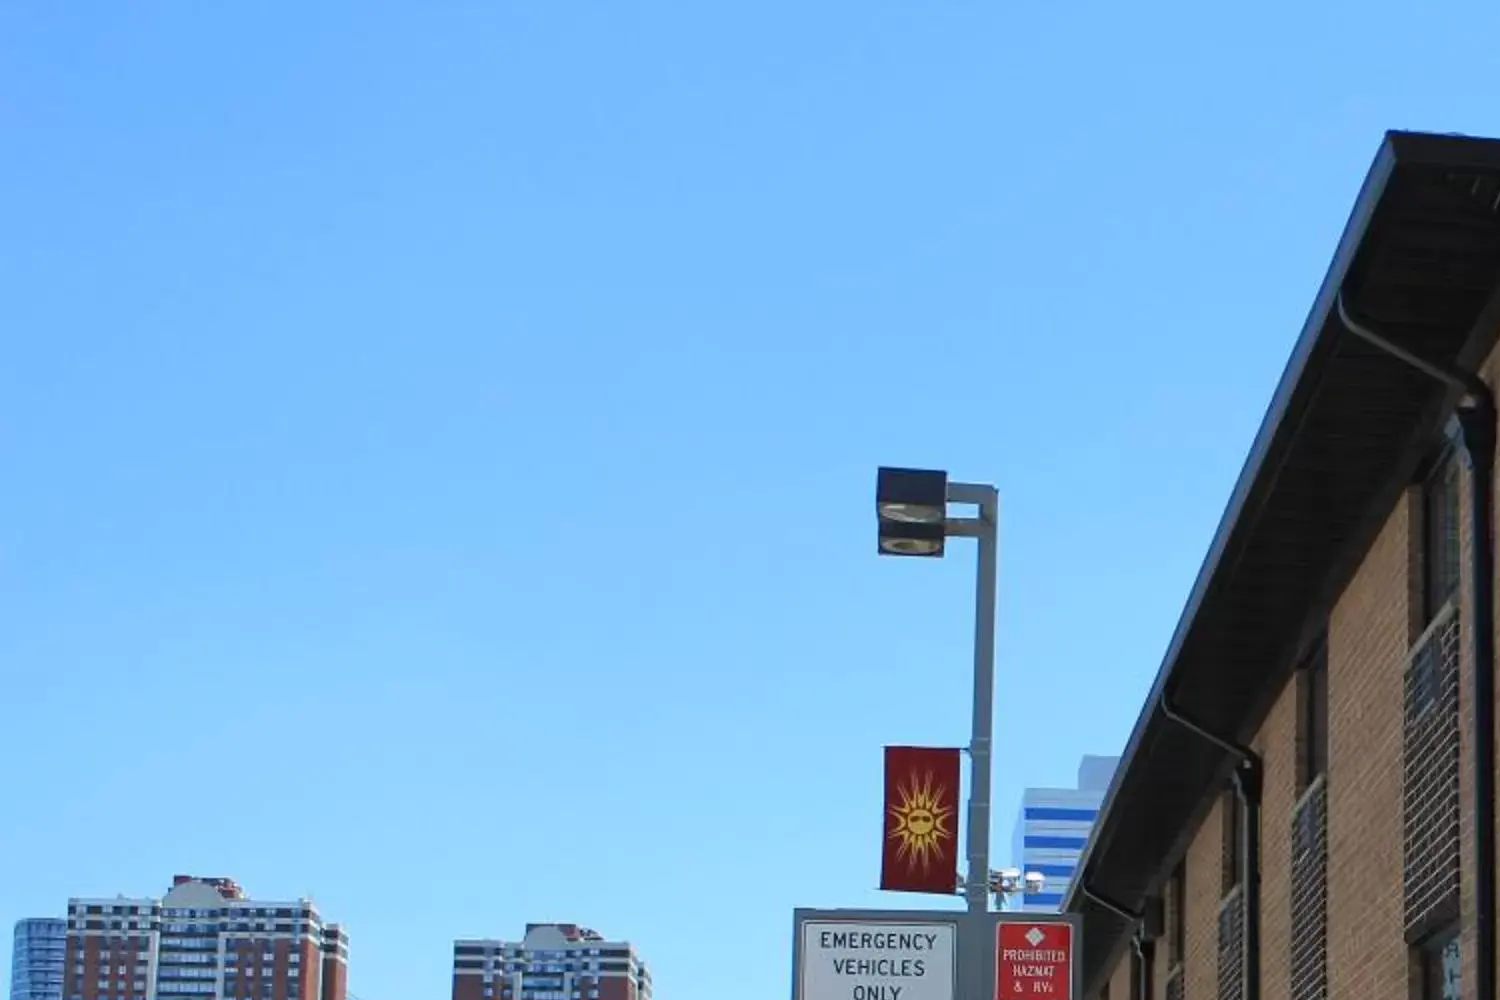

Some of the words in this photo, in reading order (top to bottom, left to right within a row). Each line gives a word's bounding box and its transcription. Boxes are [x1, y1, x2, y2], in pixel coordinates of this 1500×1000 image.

[820, 932, 937, 950] EMERGENCY
[1003, 949, 1066, 963] PROHIBITED
[833, 959, 925, 976] VEHICLES
[1013, 965, 1055, 978] HAZMAT
[1013, 981, 1023, 993] &
